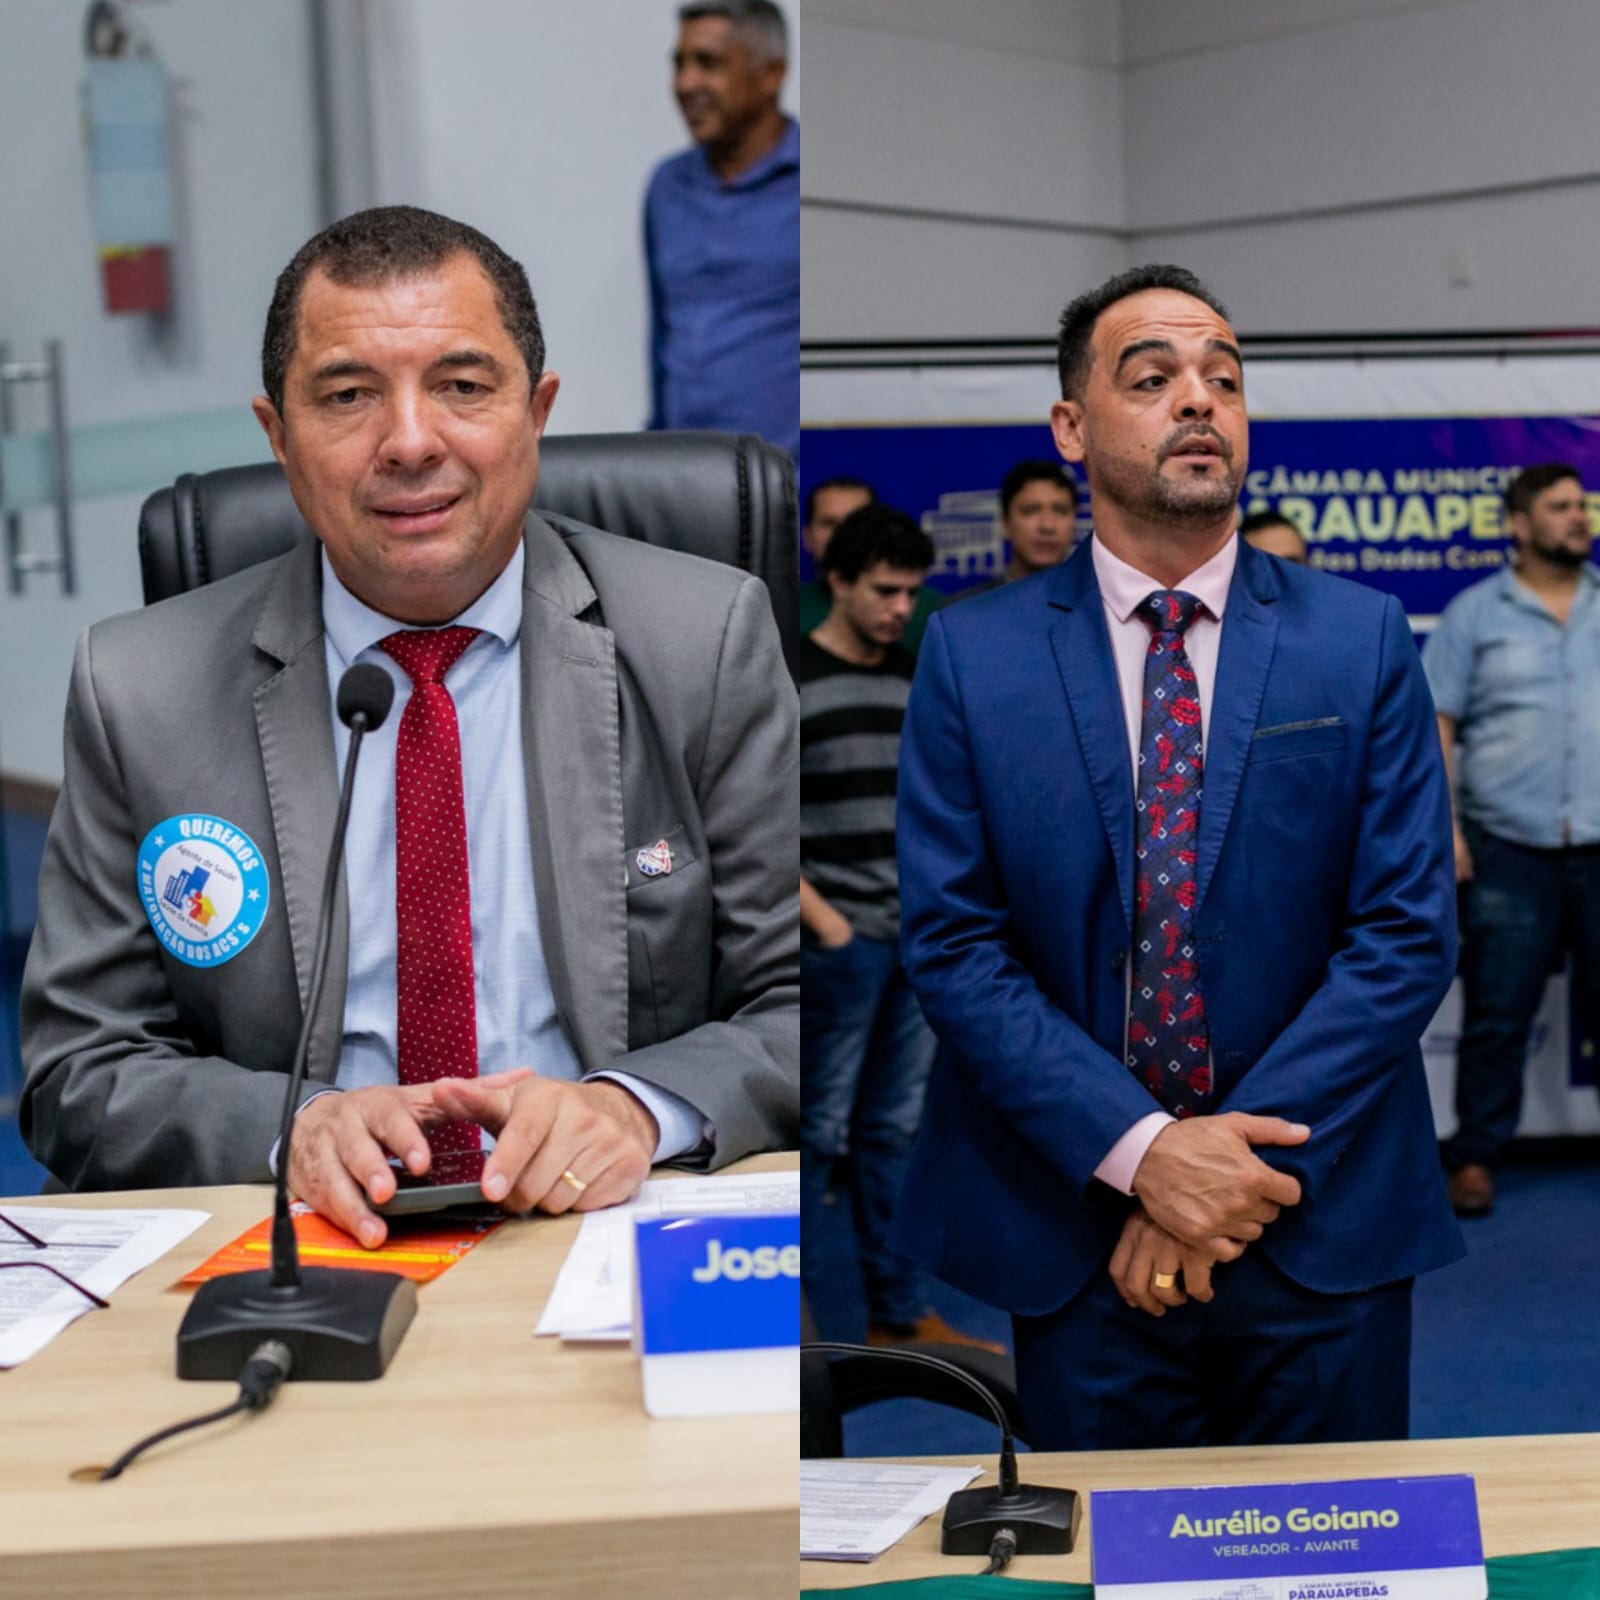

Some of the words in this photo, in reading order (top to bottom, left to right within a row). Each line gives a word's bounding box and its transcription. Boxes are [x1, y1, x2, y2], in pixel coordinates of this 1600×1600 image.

[1246, 466, 1387, 496] CÂMARA
[1393, 466, 1521, 494] MUNICI
[179, 818, 260, 872] QUEREMOS
[1169, 1509, 1281, 1538] Aurélio
[1286, 1505, 1399, 1532] Goiano
[1213, 1542, 1290, 1557] VEREADOR
[1304, 1539, 1360, 1553] AVANTE
[1288, 1585, 1390, 1600] PARAUAPEBAS
